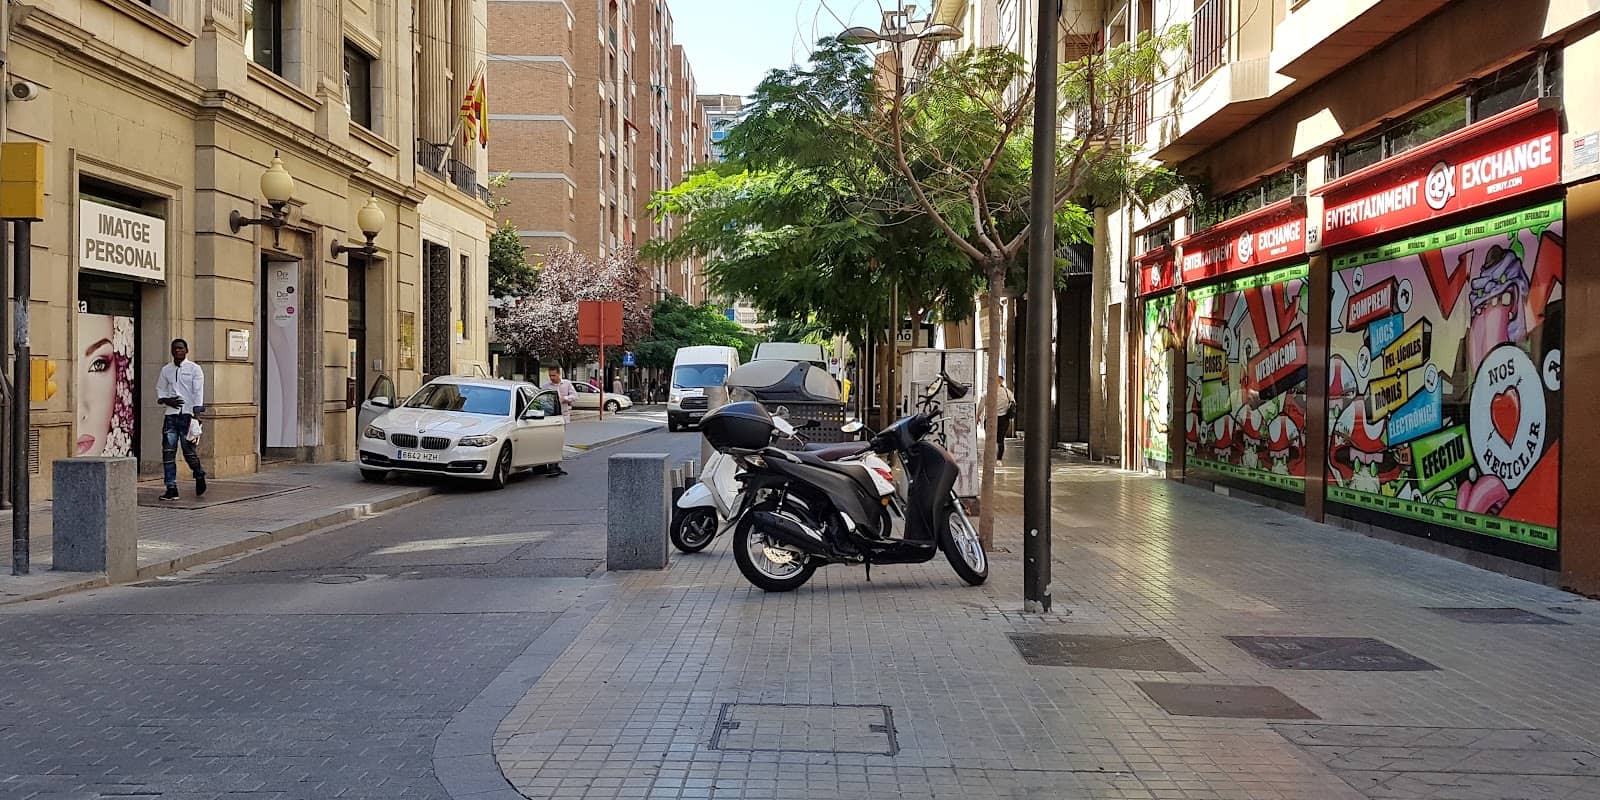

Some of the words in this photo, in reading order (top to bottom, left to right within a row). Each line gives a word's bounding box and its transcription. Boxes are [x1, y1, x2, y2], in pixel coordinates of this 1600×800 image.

[1325, 181, 1419, 231] ENTERTAINMENT
[1461, 135, 1552, 190] EXCHANGE
[98, 213, 151, 244] IMATGE
[1258, 220, 1301, 250] EXCHANGE
[85, 238, 161, 271] PERSONAL
[1255, 339, 1297, 382] WEBUY.COM
[1488, 357, 1515, 387] NOS
[1422, 434, 1465, 480] EFECTIU
[1483, 421, 1541, 480] RECICLAR
